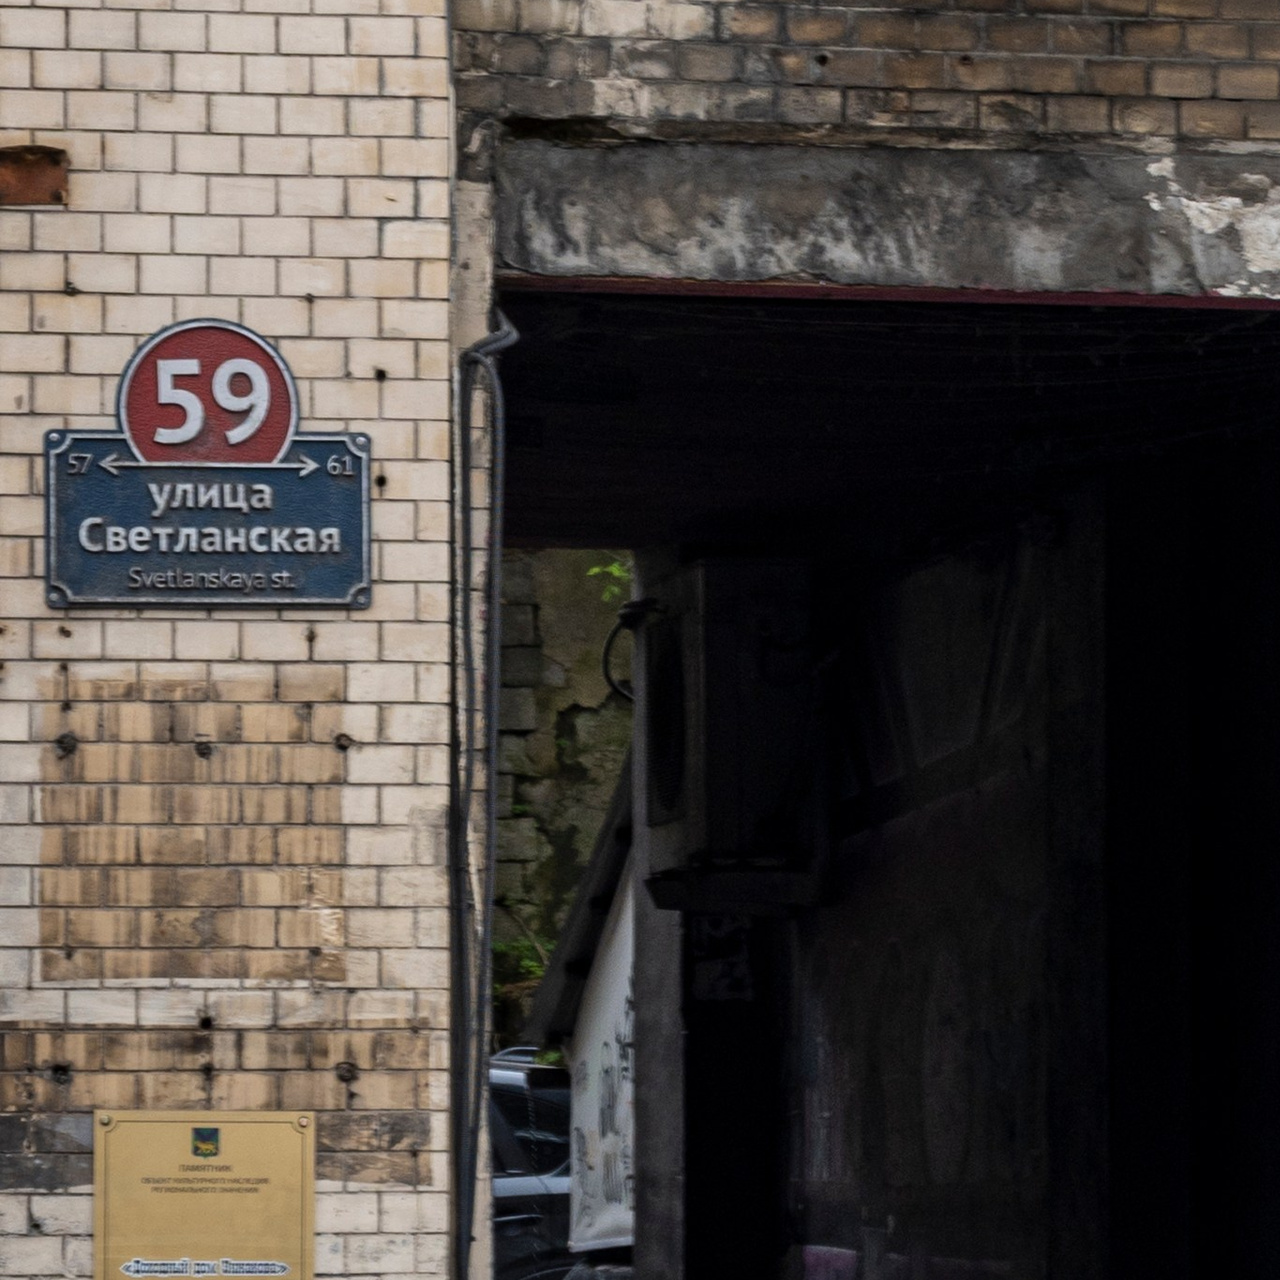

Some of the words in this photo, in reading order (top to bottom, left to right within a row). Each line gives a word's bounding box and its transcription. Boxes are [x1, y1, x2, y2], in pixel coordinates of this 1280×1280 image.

[153, 358, 271, 446] 59
[67, 454, 94, 475] 57
[326, 455, 355, 476] 61
[148, 482, 273, 517] улица
[78, 518, 341, 554] Светланская
[128, 567, 266, 594] Svetlanskaya
[271, 569, 295, 590] st.
